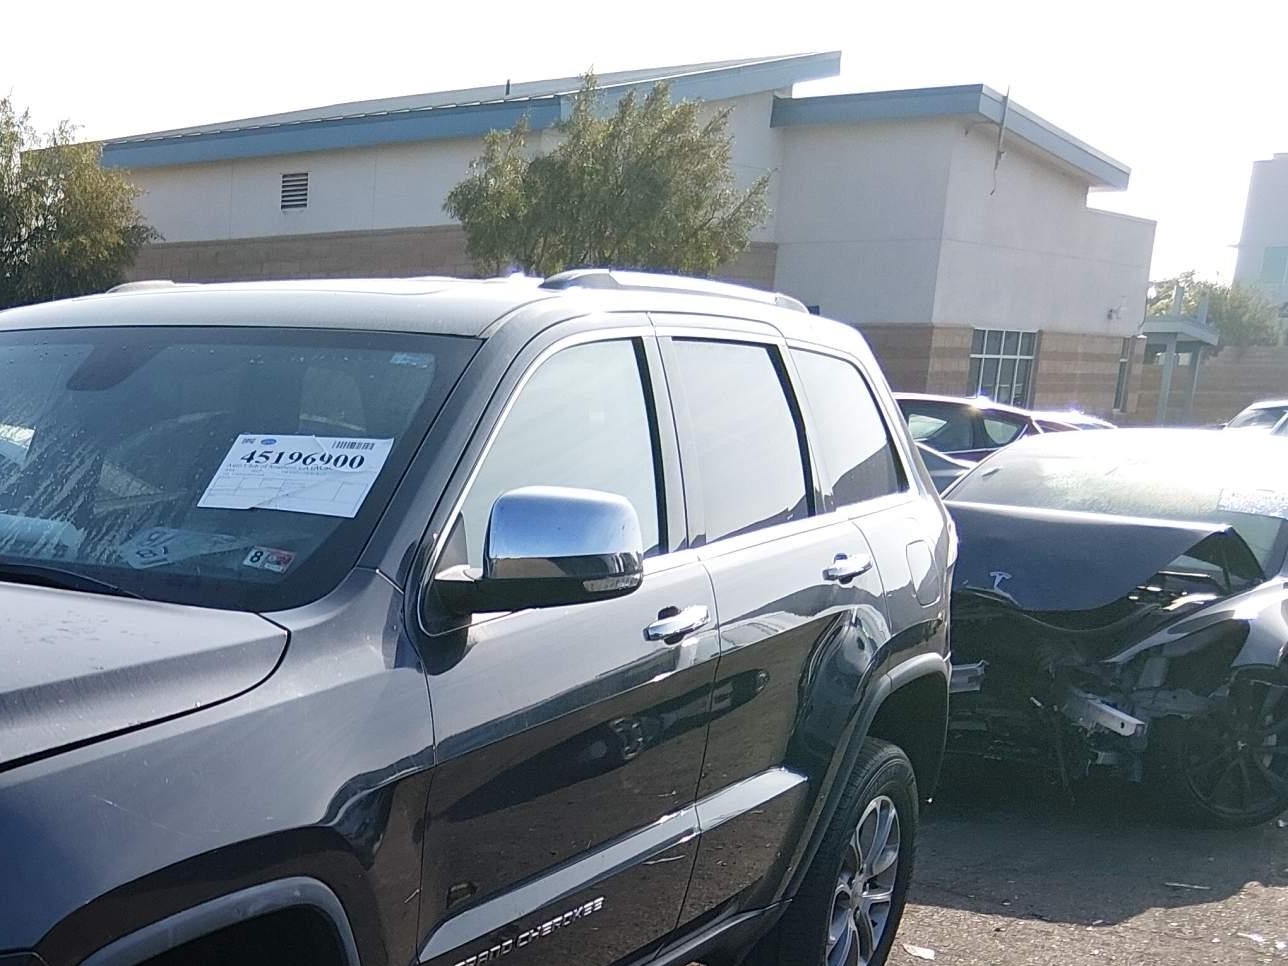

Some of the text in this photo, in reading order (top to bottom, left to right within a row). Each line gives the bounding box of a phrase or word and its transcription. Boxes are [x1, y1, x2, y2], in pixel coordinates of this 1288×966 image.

[240, 450, 365, 470] 45196900
[249, 550, 264, 564] 8
[516, 896, 605, 948] CHEROKEE
